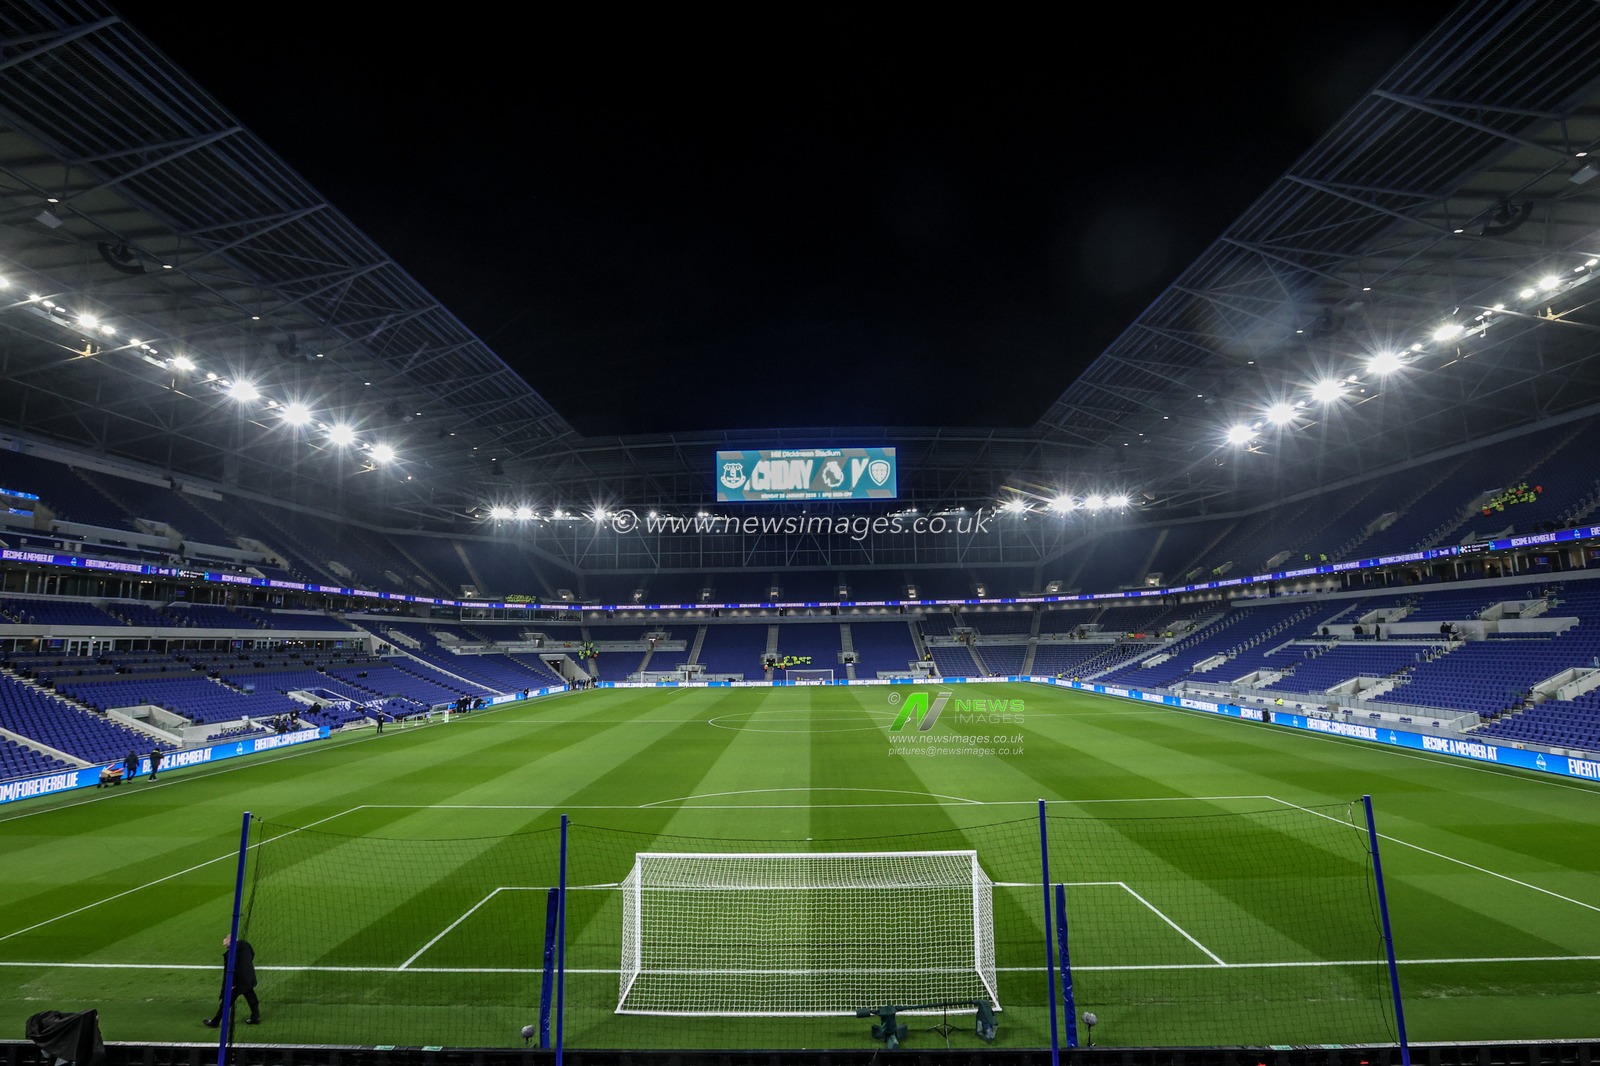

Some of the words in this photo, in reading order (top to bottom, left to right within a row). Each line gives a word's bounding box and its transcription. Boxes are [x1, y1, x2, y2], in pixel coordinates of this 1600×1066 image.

[815, 449, 841, 457] Stadium
[142, 756, 170, 773] BEME
[170, 755, 176, 768] A
[176, 749, 203, 767] MEMBER
[203, 748, 212, 761] AT
[1422, 735, 1449, 752] BECOME
[1449, 740, 1456, 754] A
[1455, 741, 1487, 759] MEMBER
[1487, 746, 1497, 761] AT
